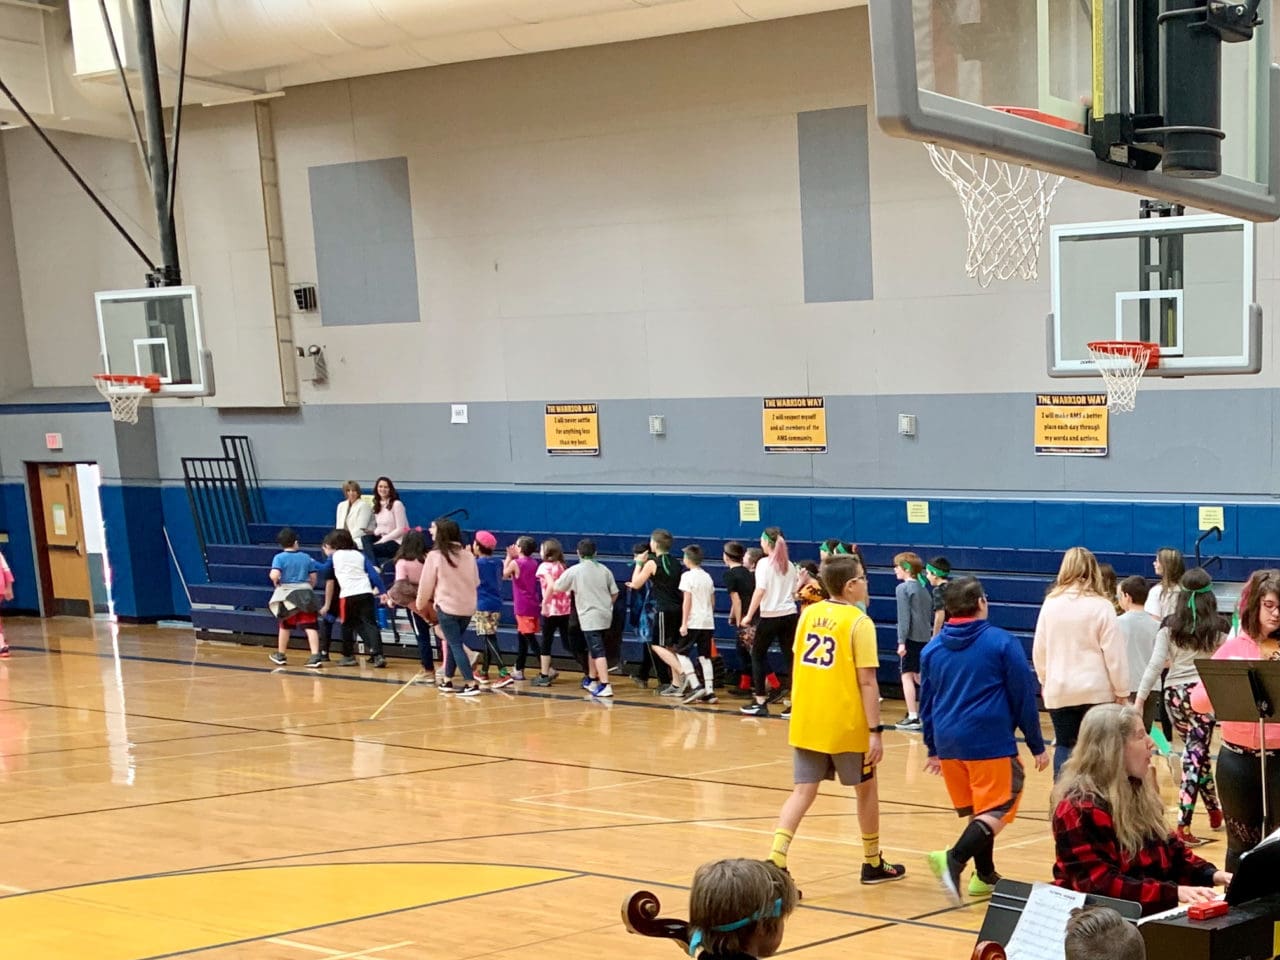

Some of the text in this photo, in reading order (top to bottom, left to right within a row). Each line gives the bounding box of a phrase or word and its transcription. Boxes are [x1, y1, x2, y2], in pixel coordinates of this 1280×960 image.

[765, 398, 822, 407] THE WARRIOR WAY
[1037, 395, 1106, 405] THE WARRIOR WAY
[803, 633, 836, 667] 23
